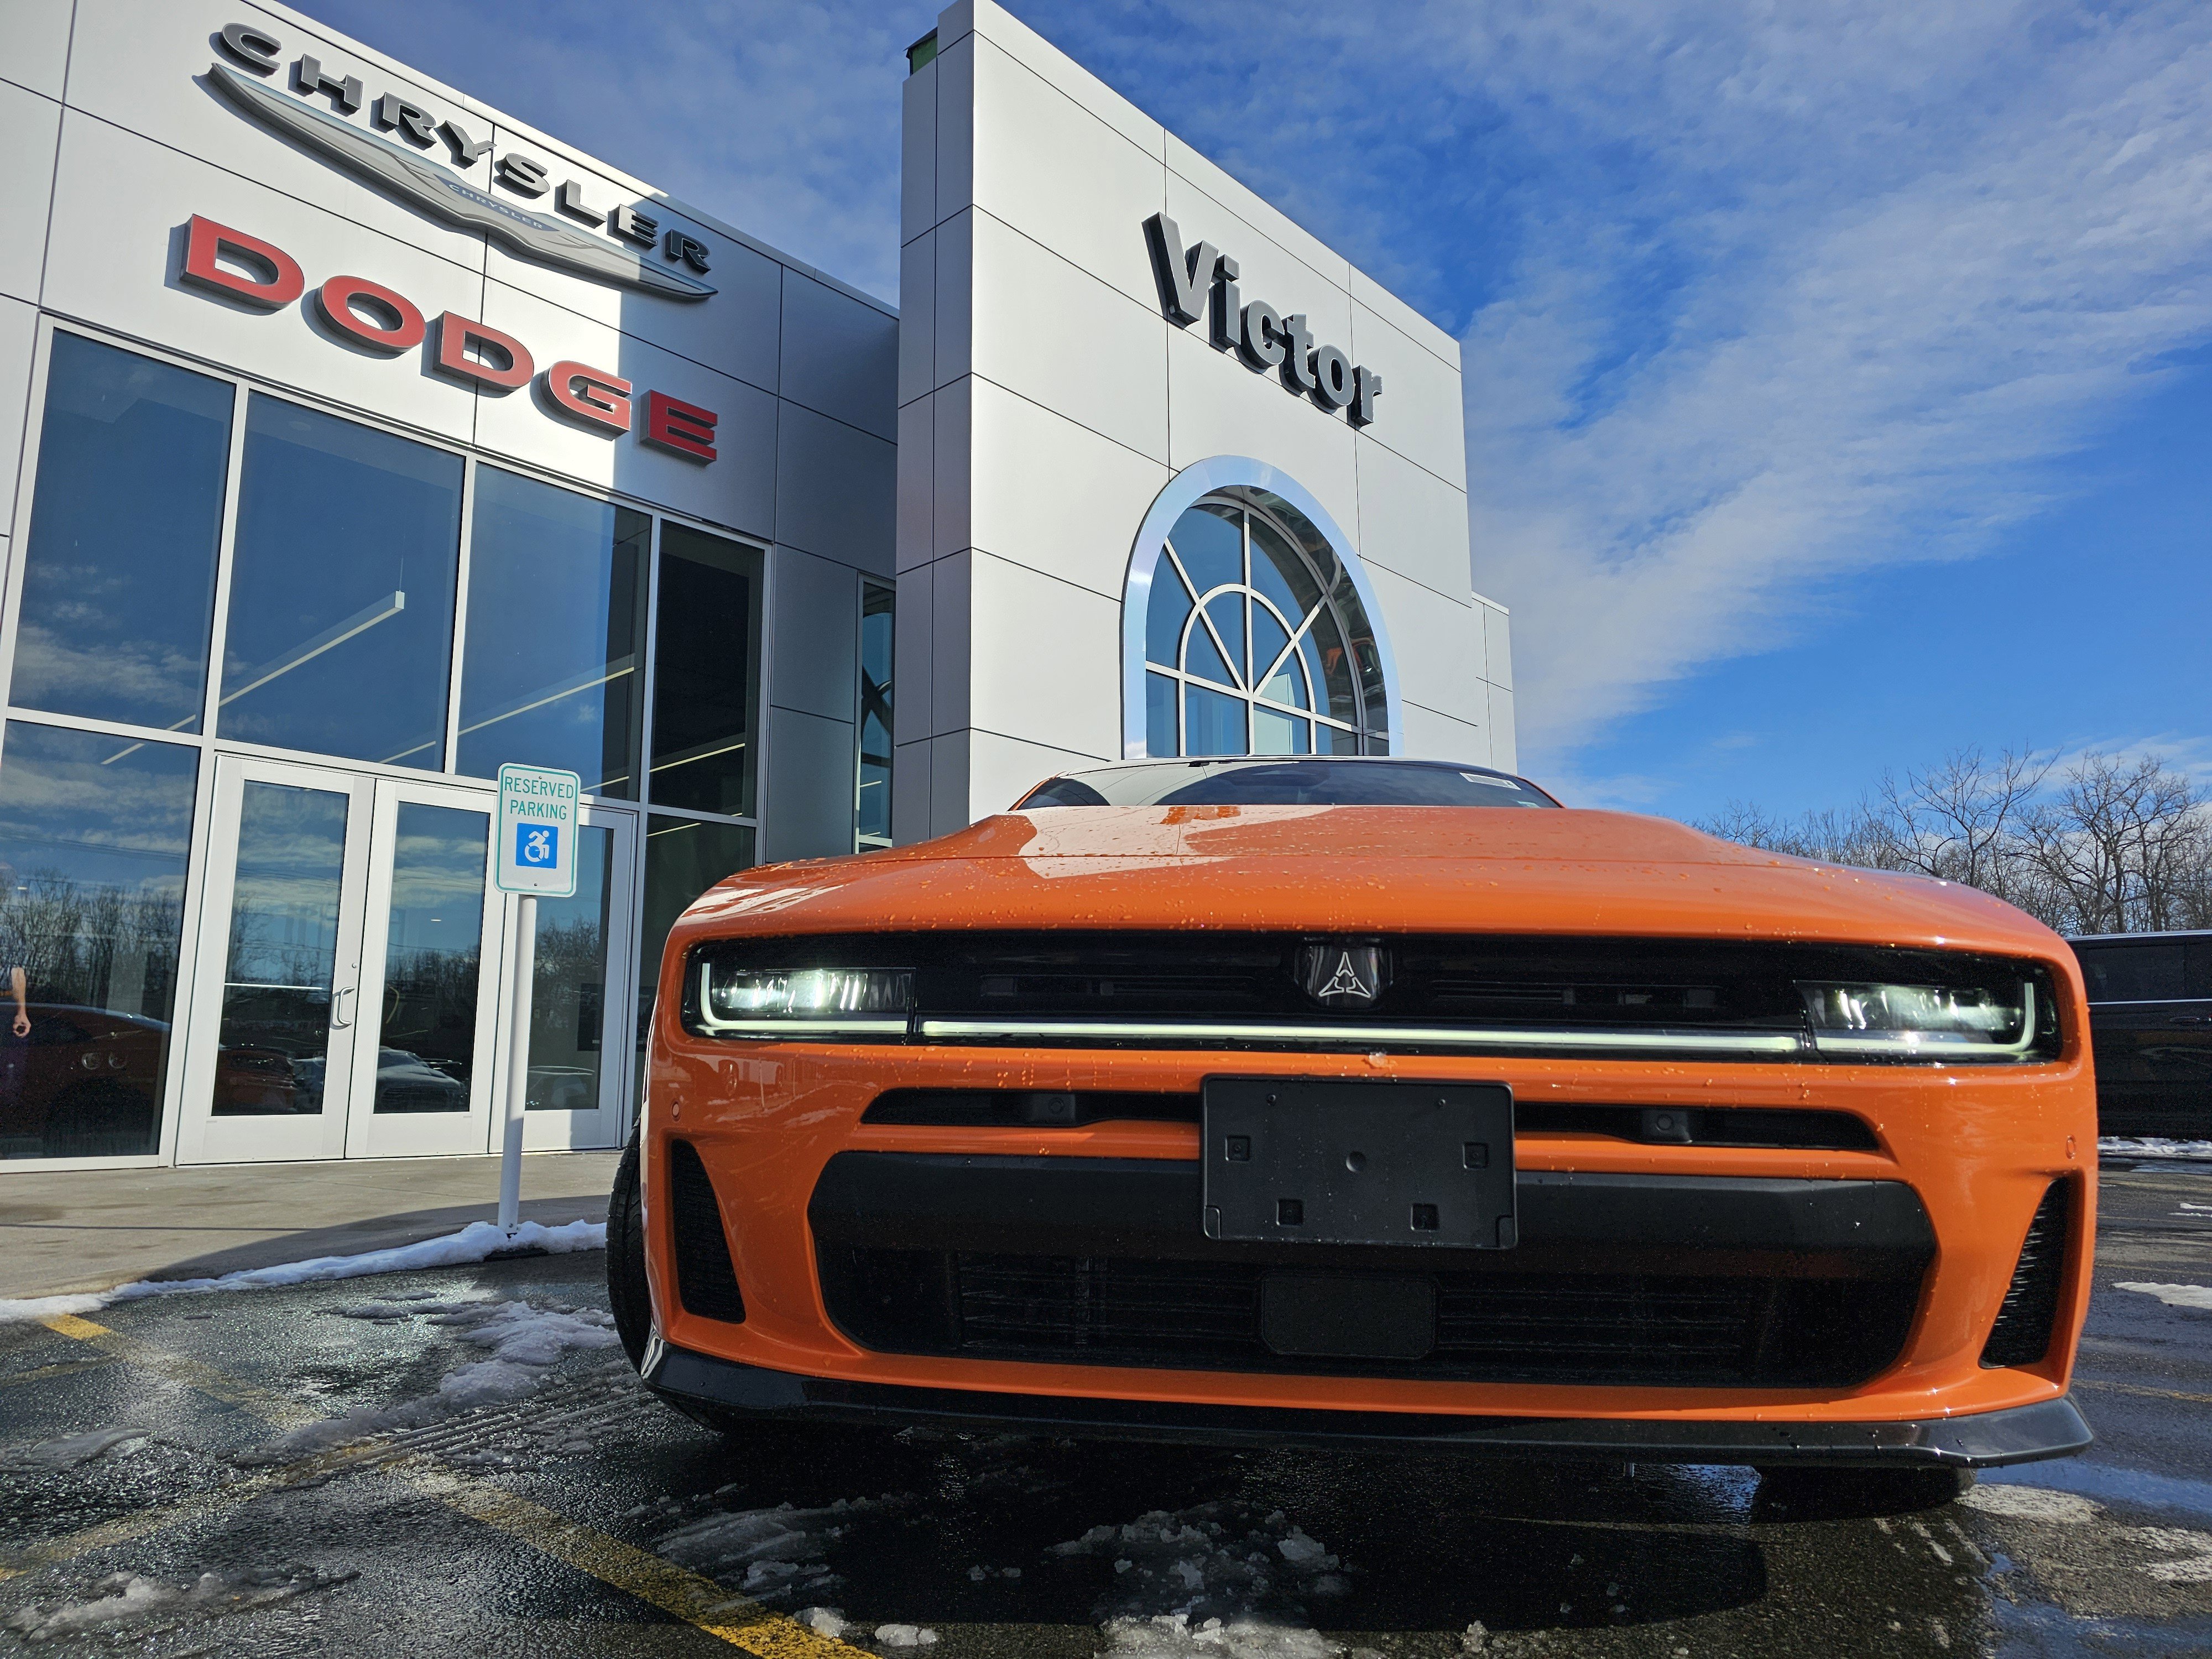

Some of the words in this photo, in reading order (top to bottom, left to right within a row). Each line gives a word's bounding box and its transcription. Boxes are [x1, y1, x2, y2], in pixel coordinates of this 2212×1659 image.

[221, 22, 711, 272] CHRYSLER
[448, 184, 543, 229] CHRYSLER
[181, 213, 718, 465] DODGE
[1141, 211, 1383, 427] Victor
[504, 776, 574, 799] RESERVED
[510, 799, 567, 820] PARKING
